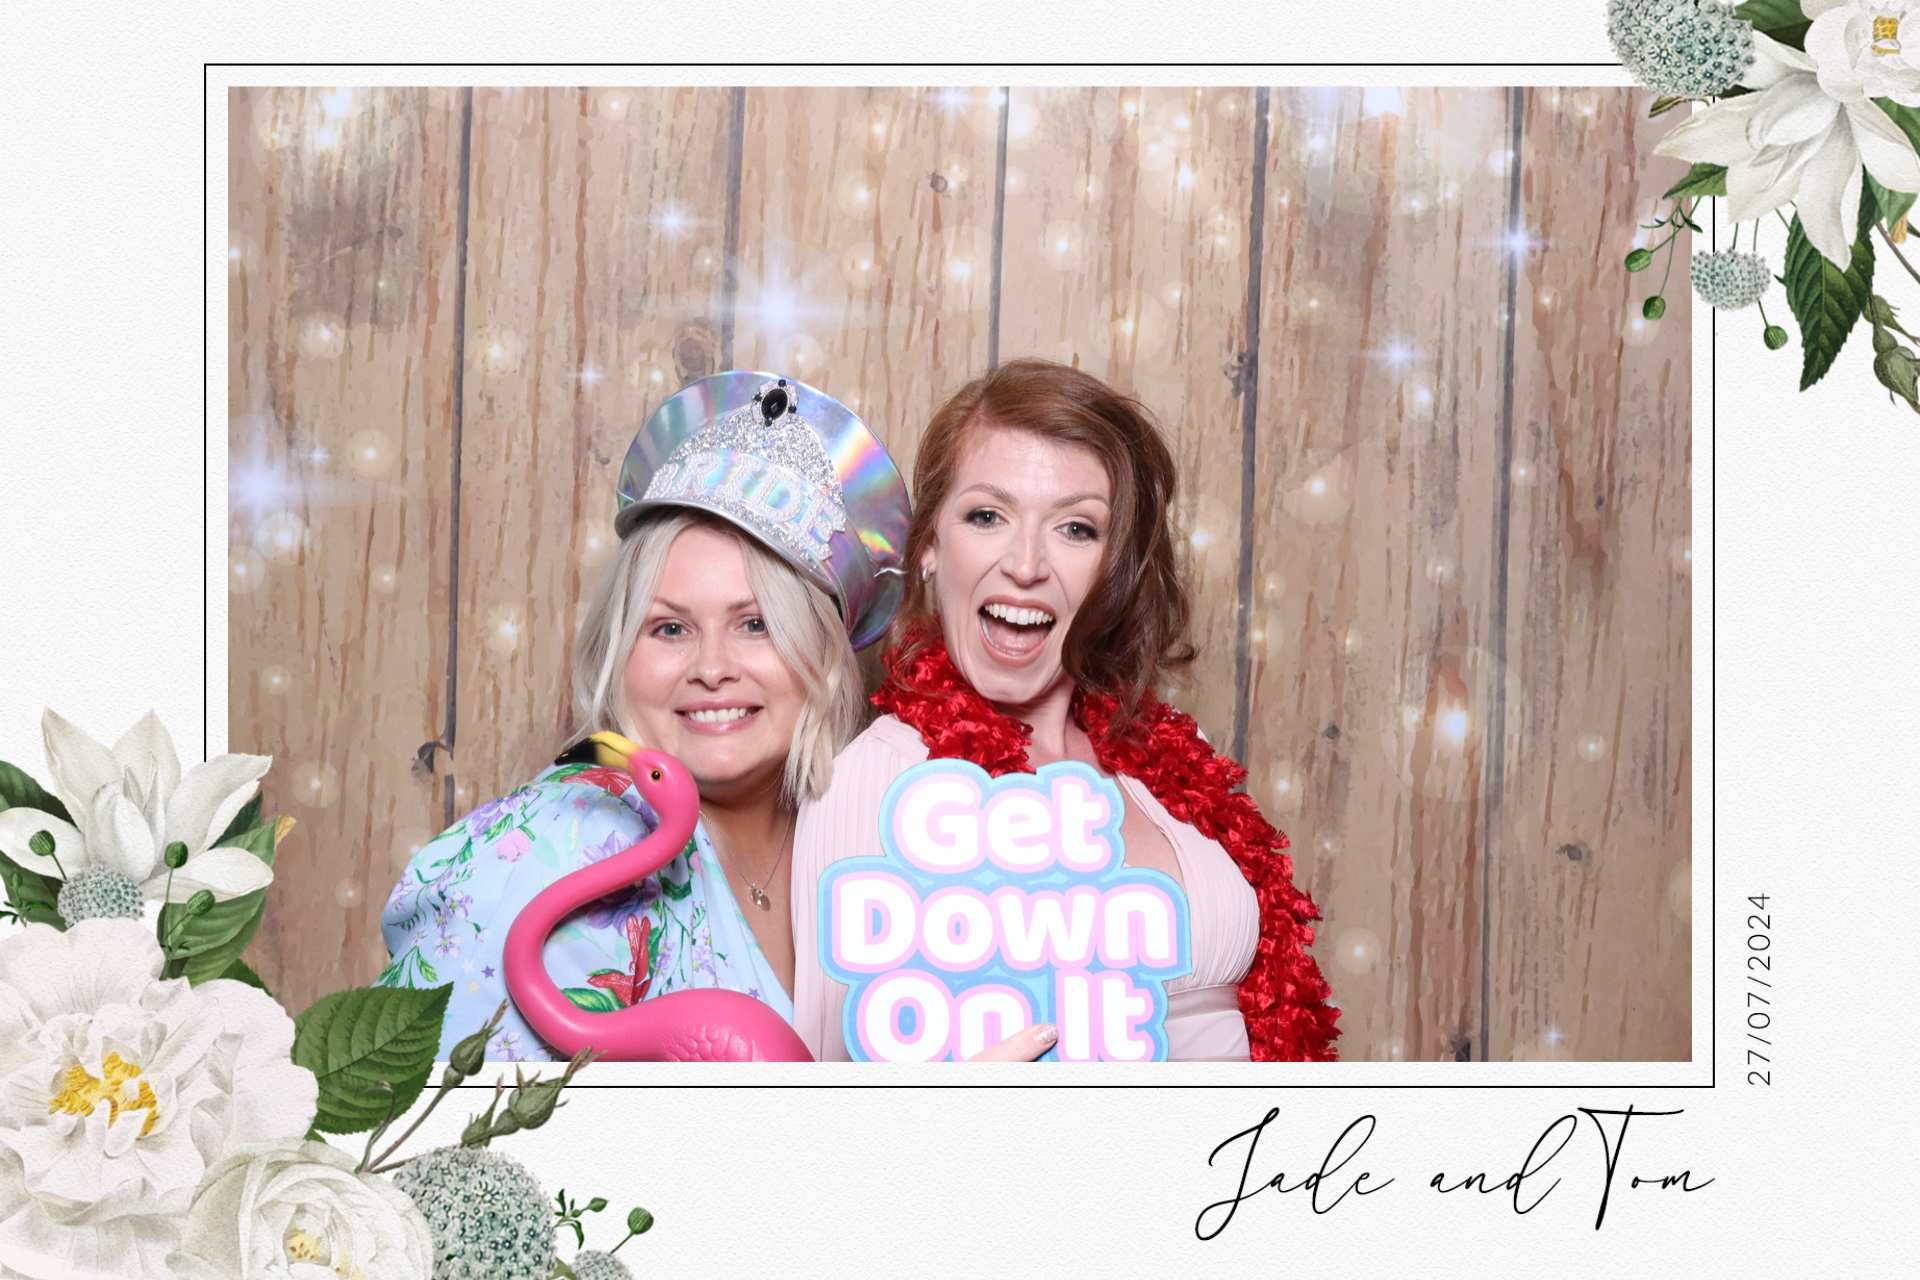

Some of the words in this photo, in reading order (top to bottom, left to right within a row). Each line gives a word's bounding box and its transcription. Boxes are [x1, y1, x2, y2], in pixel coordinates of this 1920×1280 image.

[900, 779, 1105, 868] Get
[839, 877, 1171, 966] Down
[864, 975, 1026, 1062] On
[1062, 974, 1148, 1062] It
